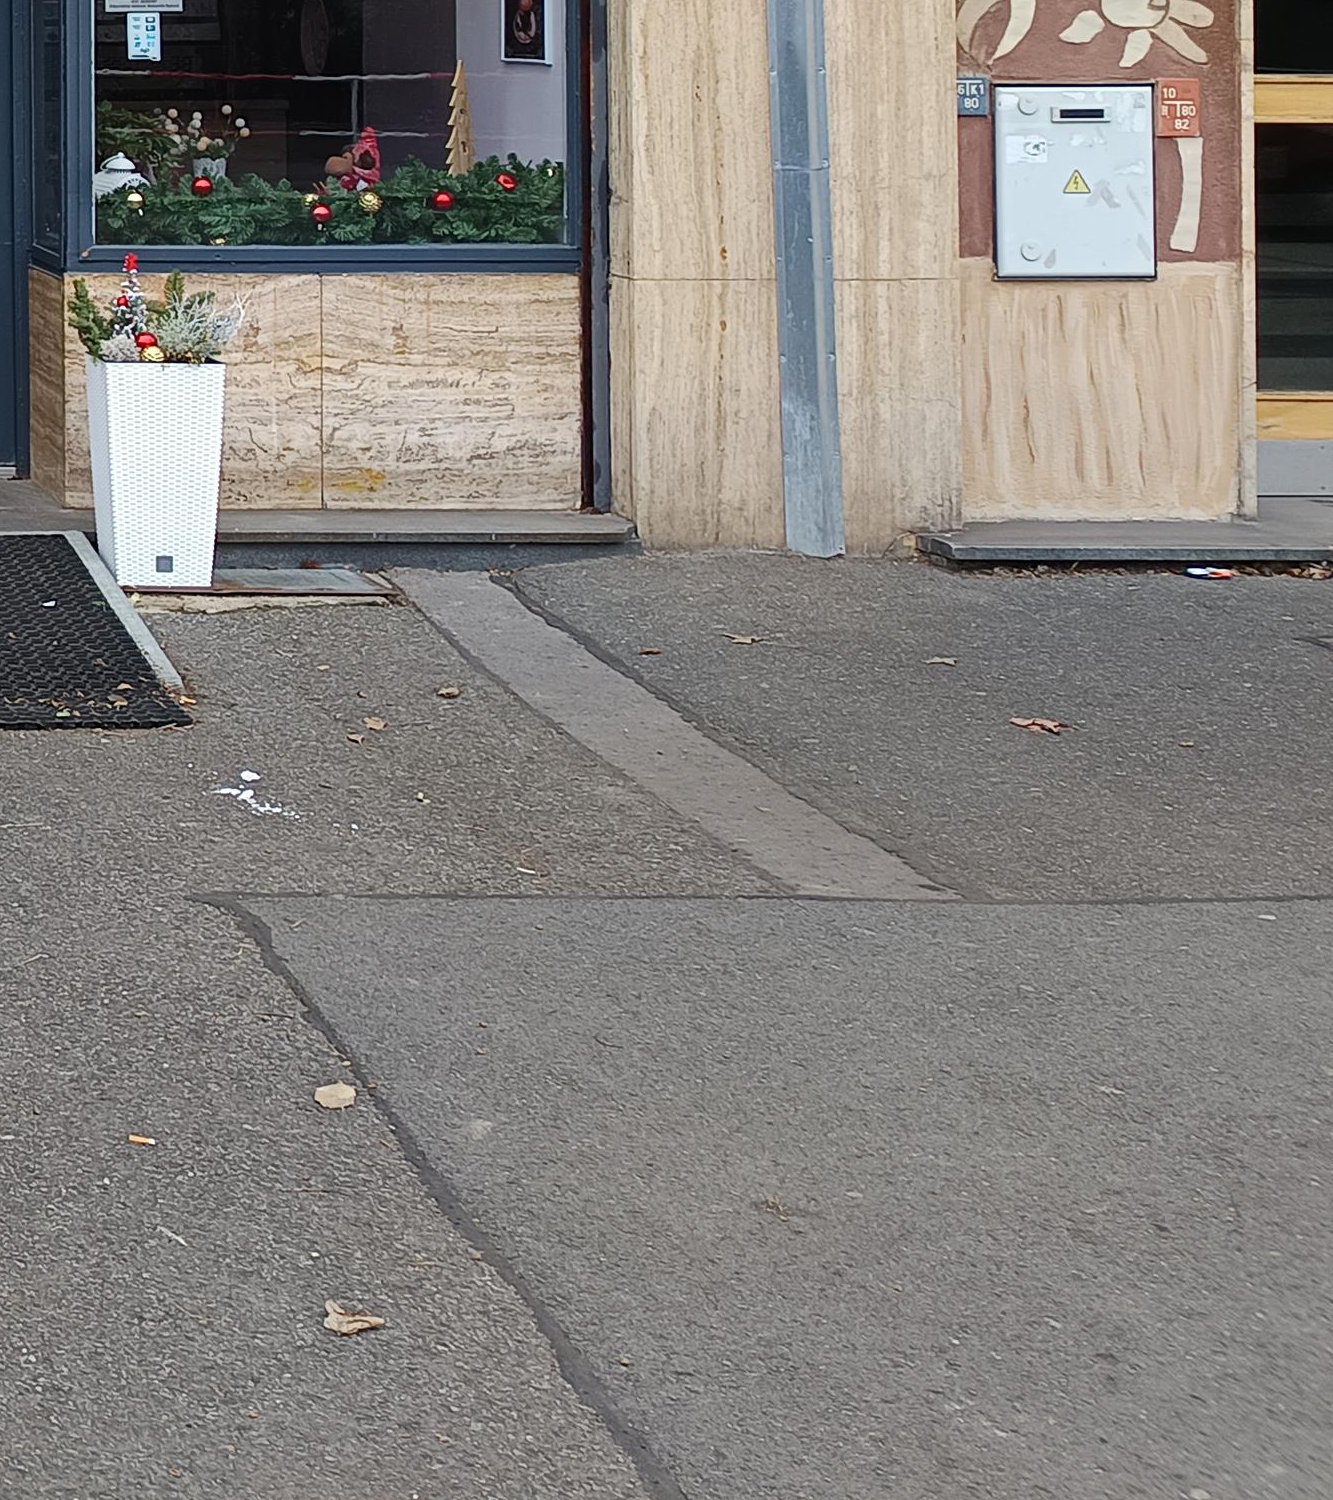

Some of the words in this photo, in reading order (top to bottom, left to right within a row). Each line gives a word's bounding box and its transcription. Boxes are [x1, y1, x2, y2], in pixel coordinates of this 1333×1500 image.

[1162, 87, 1176, 99] 10
[963, 97, 979, 109] 80
[1181, 105, 1196, 116] 80
[1174, 118, 1190, 130] 82
